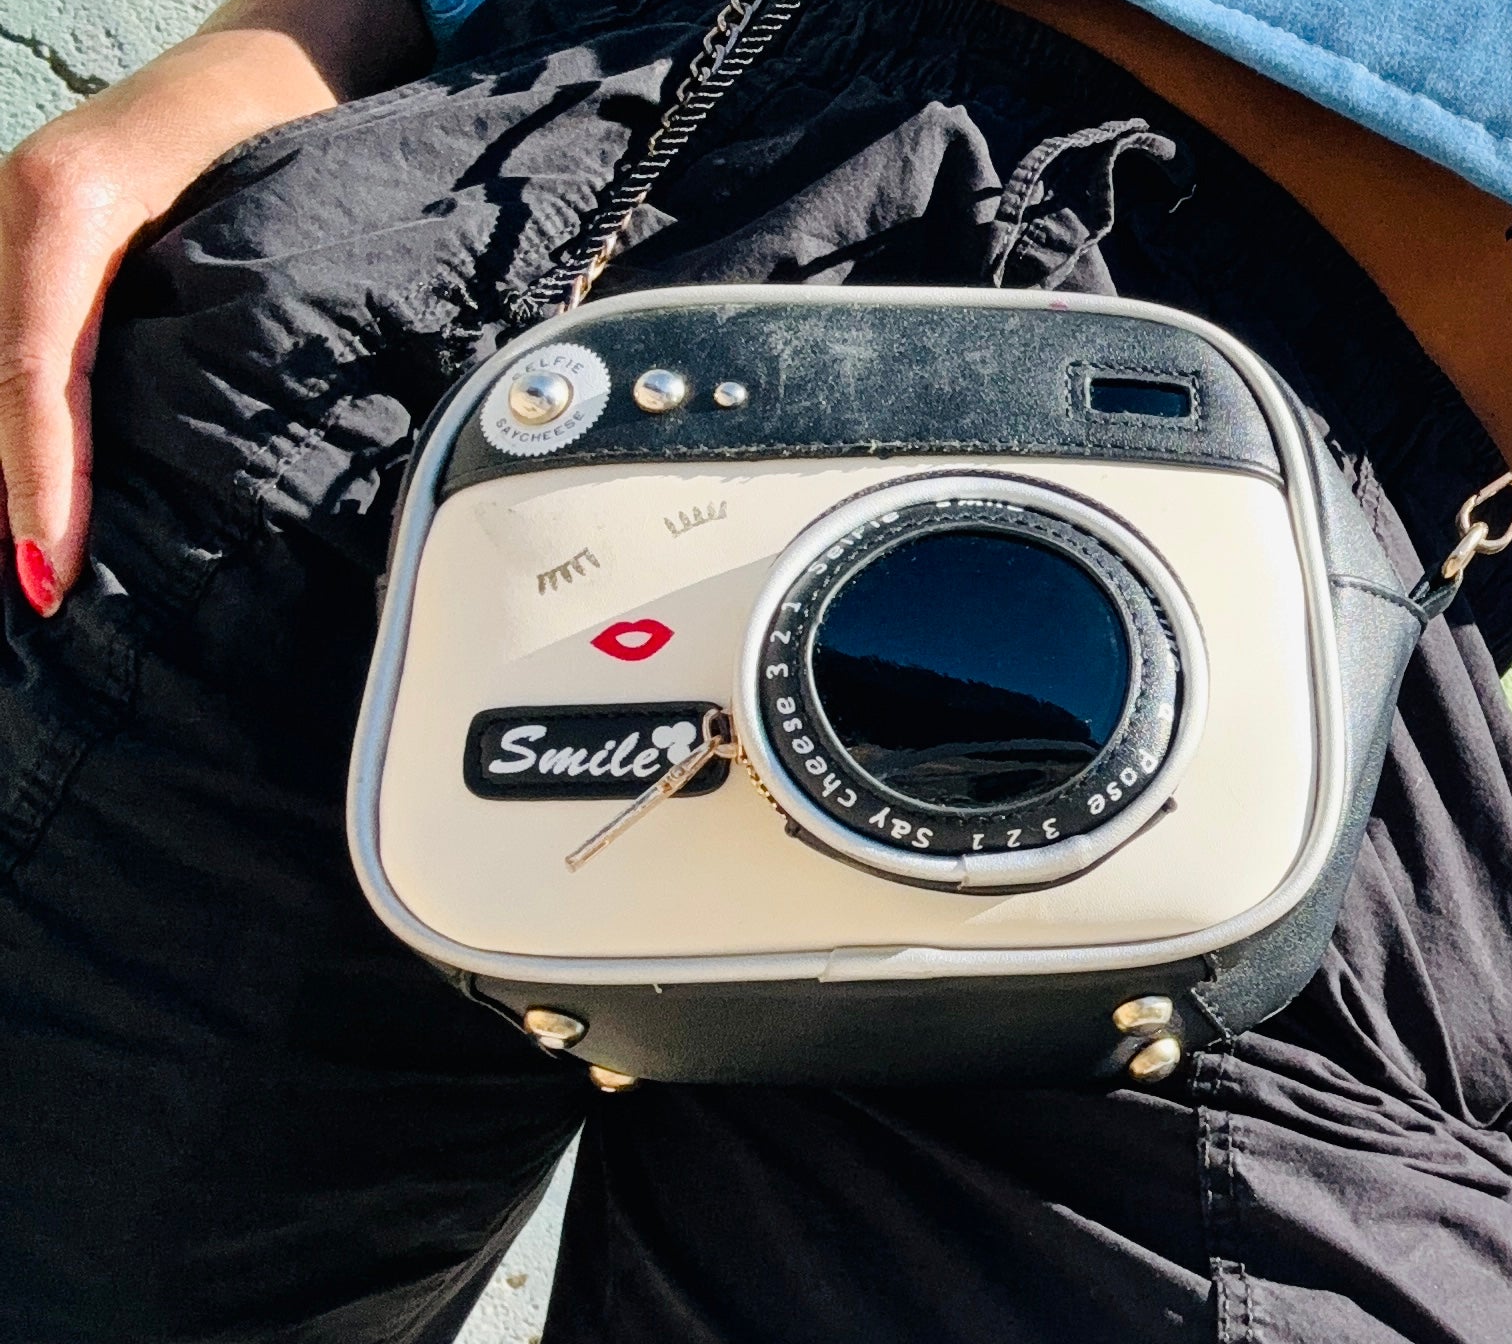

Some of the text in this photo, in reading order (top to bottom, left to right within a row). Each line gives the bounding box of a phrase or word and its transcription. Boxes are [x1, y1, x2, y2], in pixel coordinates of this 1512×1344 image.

[496, 411, 584, 442] SAYCHEESE
[781, 602, 802, 613] 1
[770, 630, 791, 645] 2
[766, 662, 789, 680] 3
[488, 724, 661, 777] Smile
[776, 696, 857, 807] cheese
[1086, 748, 1159, 815] Pose
[1006, 828, 1023, 848] 2
[1041, 817, 1060, 840] 3
[972, 833, 985, 851] 1
